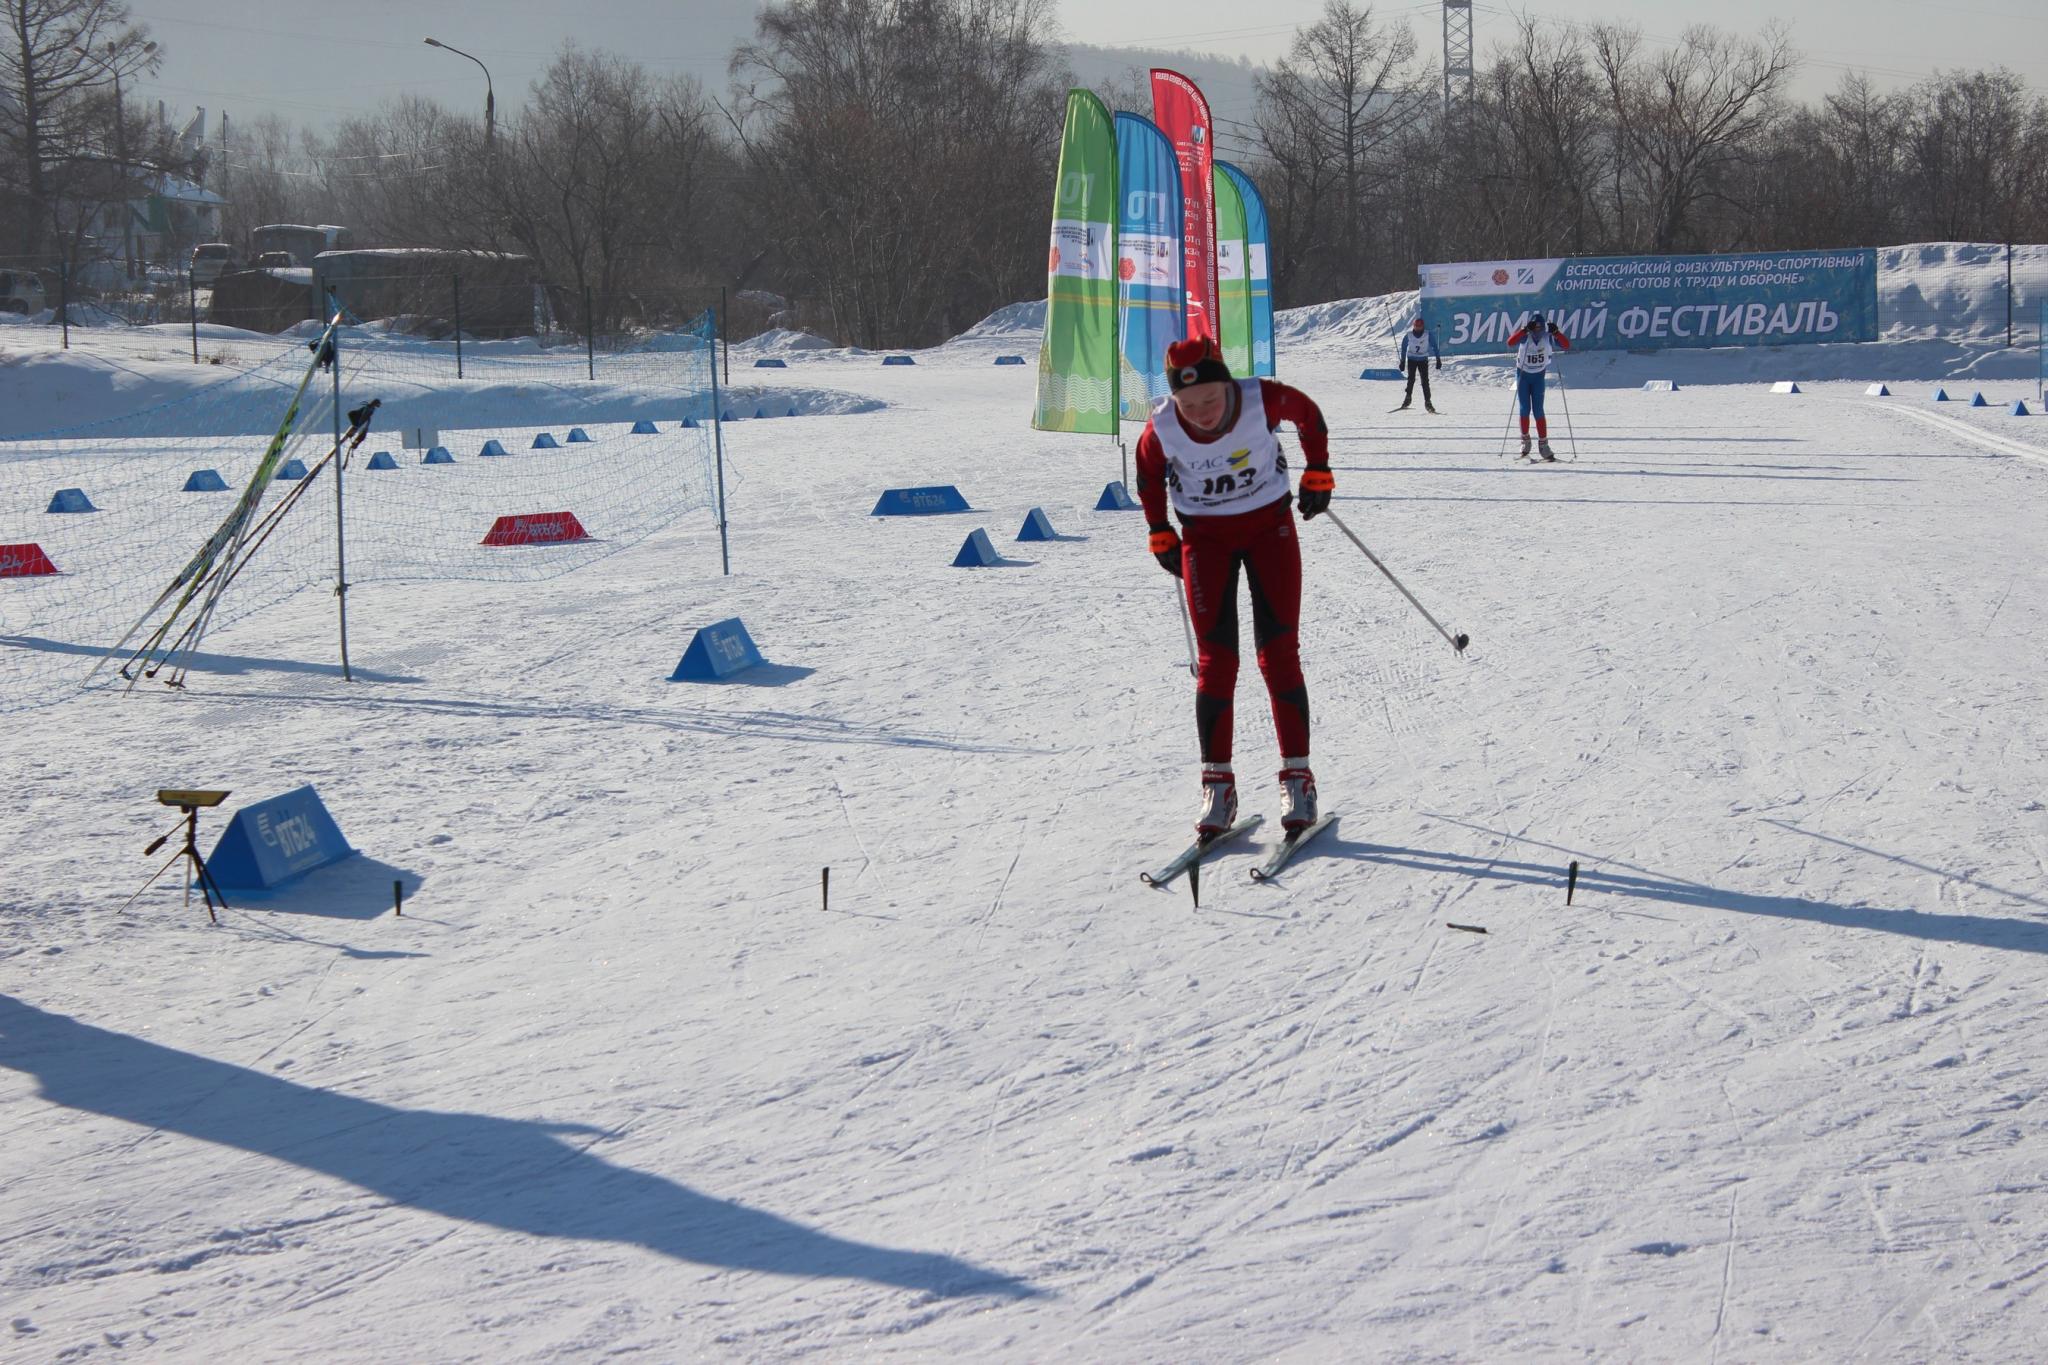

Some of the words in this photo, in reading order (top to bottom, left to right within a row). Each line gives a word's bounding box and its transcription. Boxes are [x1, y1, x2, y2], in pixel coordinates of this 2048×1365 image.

[1566, 261, 1671, 276] ВСЕРОССИЙСКИЙ
[1674, 254, 1865, 275] ФИЗКУЛЬТУРНО-СПОРТИВНЫЙ
[1556, 278, 1623, 291] КОМПЛЕКС
[1625, 276, 1671, 290] «ГОТОВ
[1673, 276, 1682, 288] К
[1686, 275, 1726, 289] ТРУДУ
[1727, 275, 1736, 286] И
[1739, 272, 1805, 286] ОБОРОНЕ»
[1617, 301, 1839, 339] ФЕСТИВАЛЬ
[1527, 353, 1545, 364] 165
[912, 494, 946, 508] ВТБ24
[275, 814, 316, 858] ВТБ24
